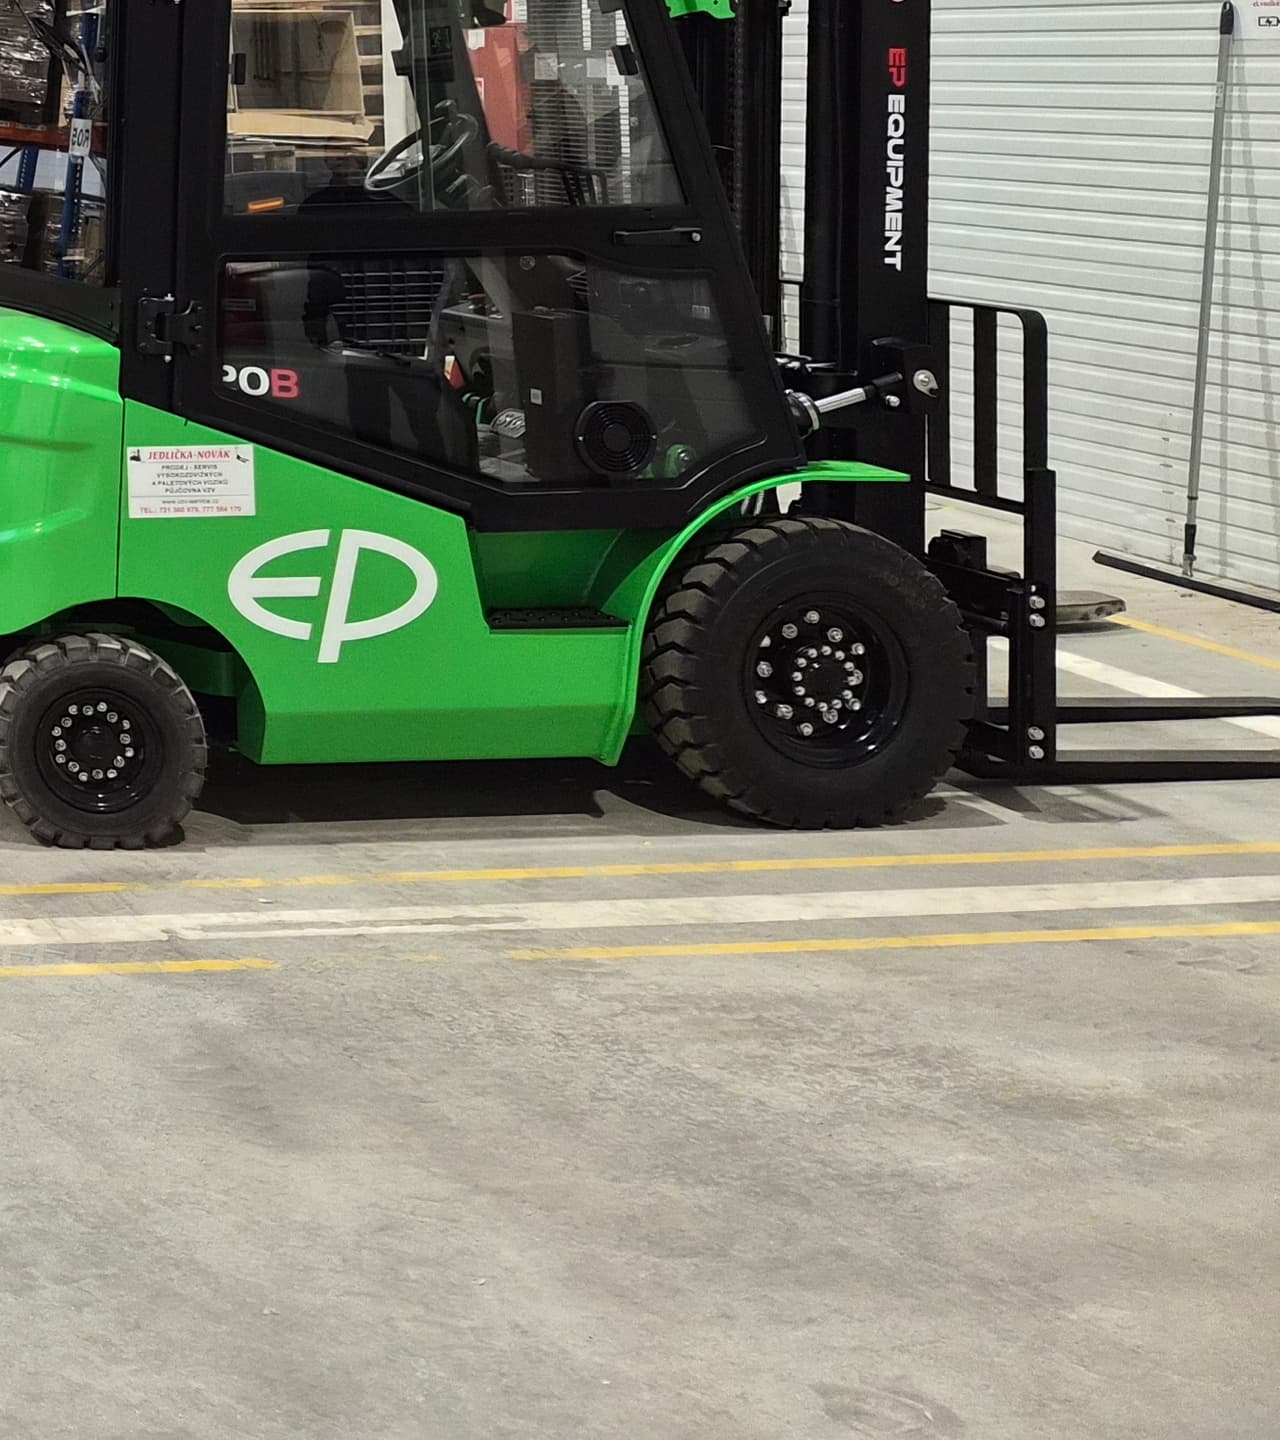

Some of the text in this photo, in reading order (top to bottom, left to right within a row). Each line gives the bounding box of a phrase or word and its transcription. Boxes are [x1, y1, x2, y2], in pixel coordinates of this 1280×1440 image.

[884, 48, 907, 272] EP EQUIPMENT
[227, 528, 438, 663] EP
